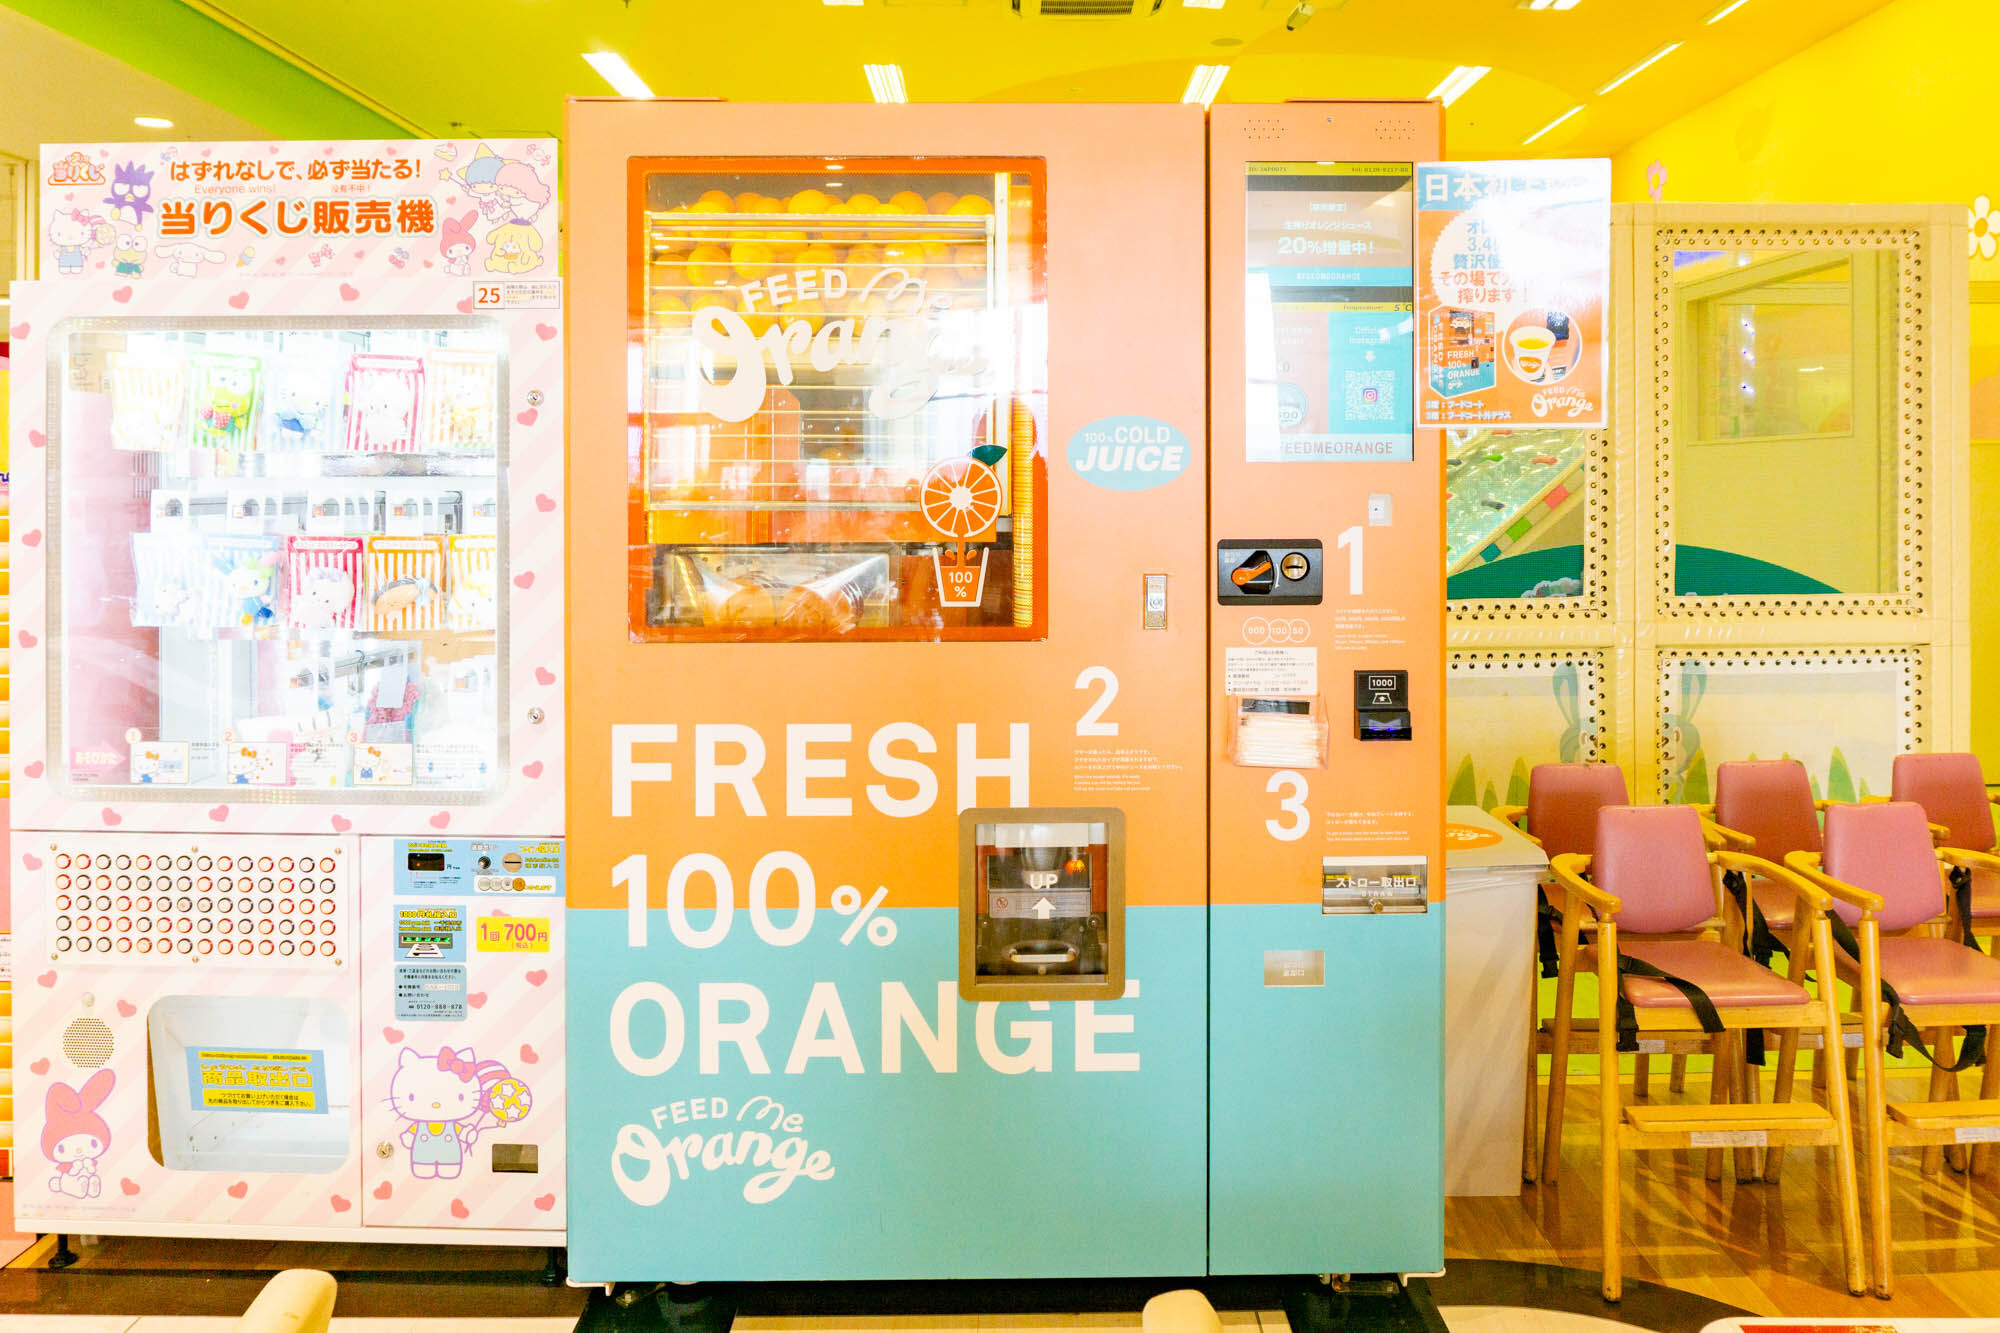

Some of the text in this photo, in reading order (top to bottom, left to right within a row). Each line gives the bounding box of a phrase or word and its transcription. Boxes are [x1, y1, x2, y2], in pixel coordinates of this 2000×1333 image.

[194, 184, 245, 194] Everyone
[160, 199, 435, 235] 当りくじ販売機
[478, 287, 501, 304] 25
[741, 269, 848, 313] FEED
[691, 306, 997, 422] Orang
[1531, 393, 1593, 417] Orange
[1114, 424, 1171, 444] COLD
[1075, 445, 1184, 472] JUICE
[1337, 525, 1364, 595] 1
[948, 571, 973, 584] 100
[954, 585, 967, 598] %
[1372, 679, 1393, 687] 1000
[1074, 665, 1120, 737] 2
[611, 721, 1031, 818] FRESH
[1265, 770, 1311, 841] 3
[1029, 872, 1059, 890] UP
[1335, 876, 1417, 888] ストロー取出口
[610, 850, 898, 949] 100%
[503, 923, 548, 942] 700円
[609, 979, 1141, 1077] ORANGE
[201, 1070, 313, 1088] 商品取出口
[651, 1096, 729, 1130] FEED
[611, 1122, 836, 1207] Orange
